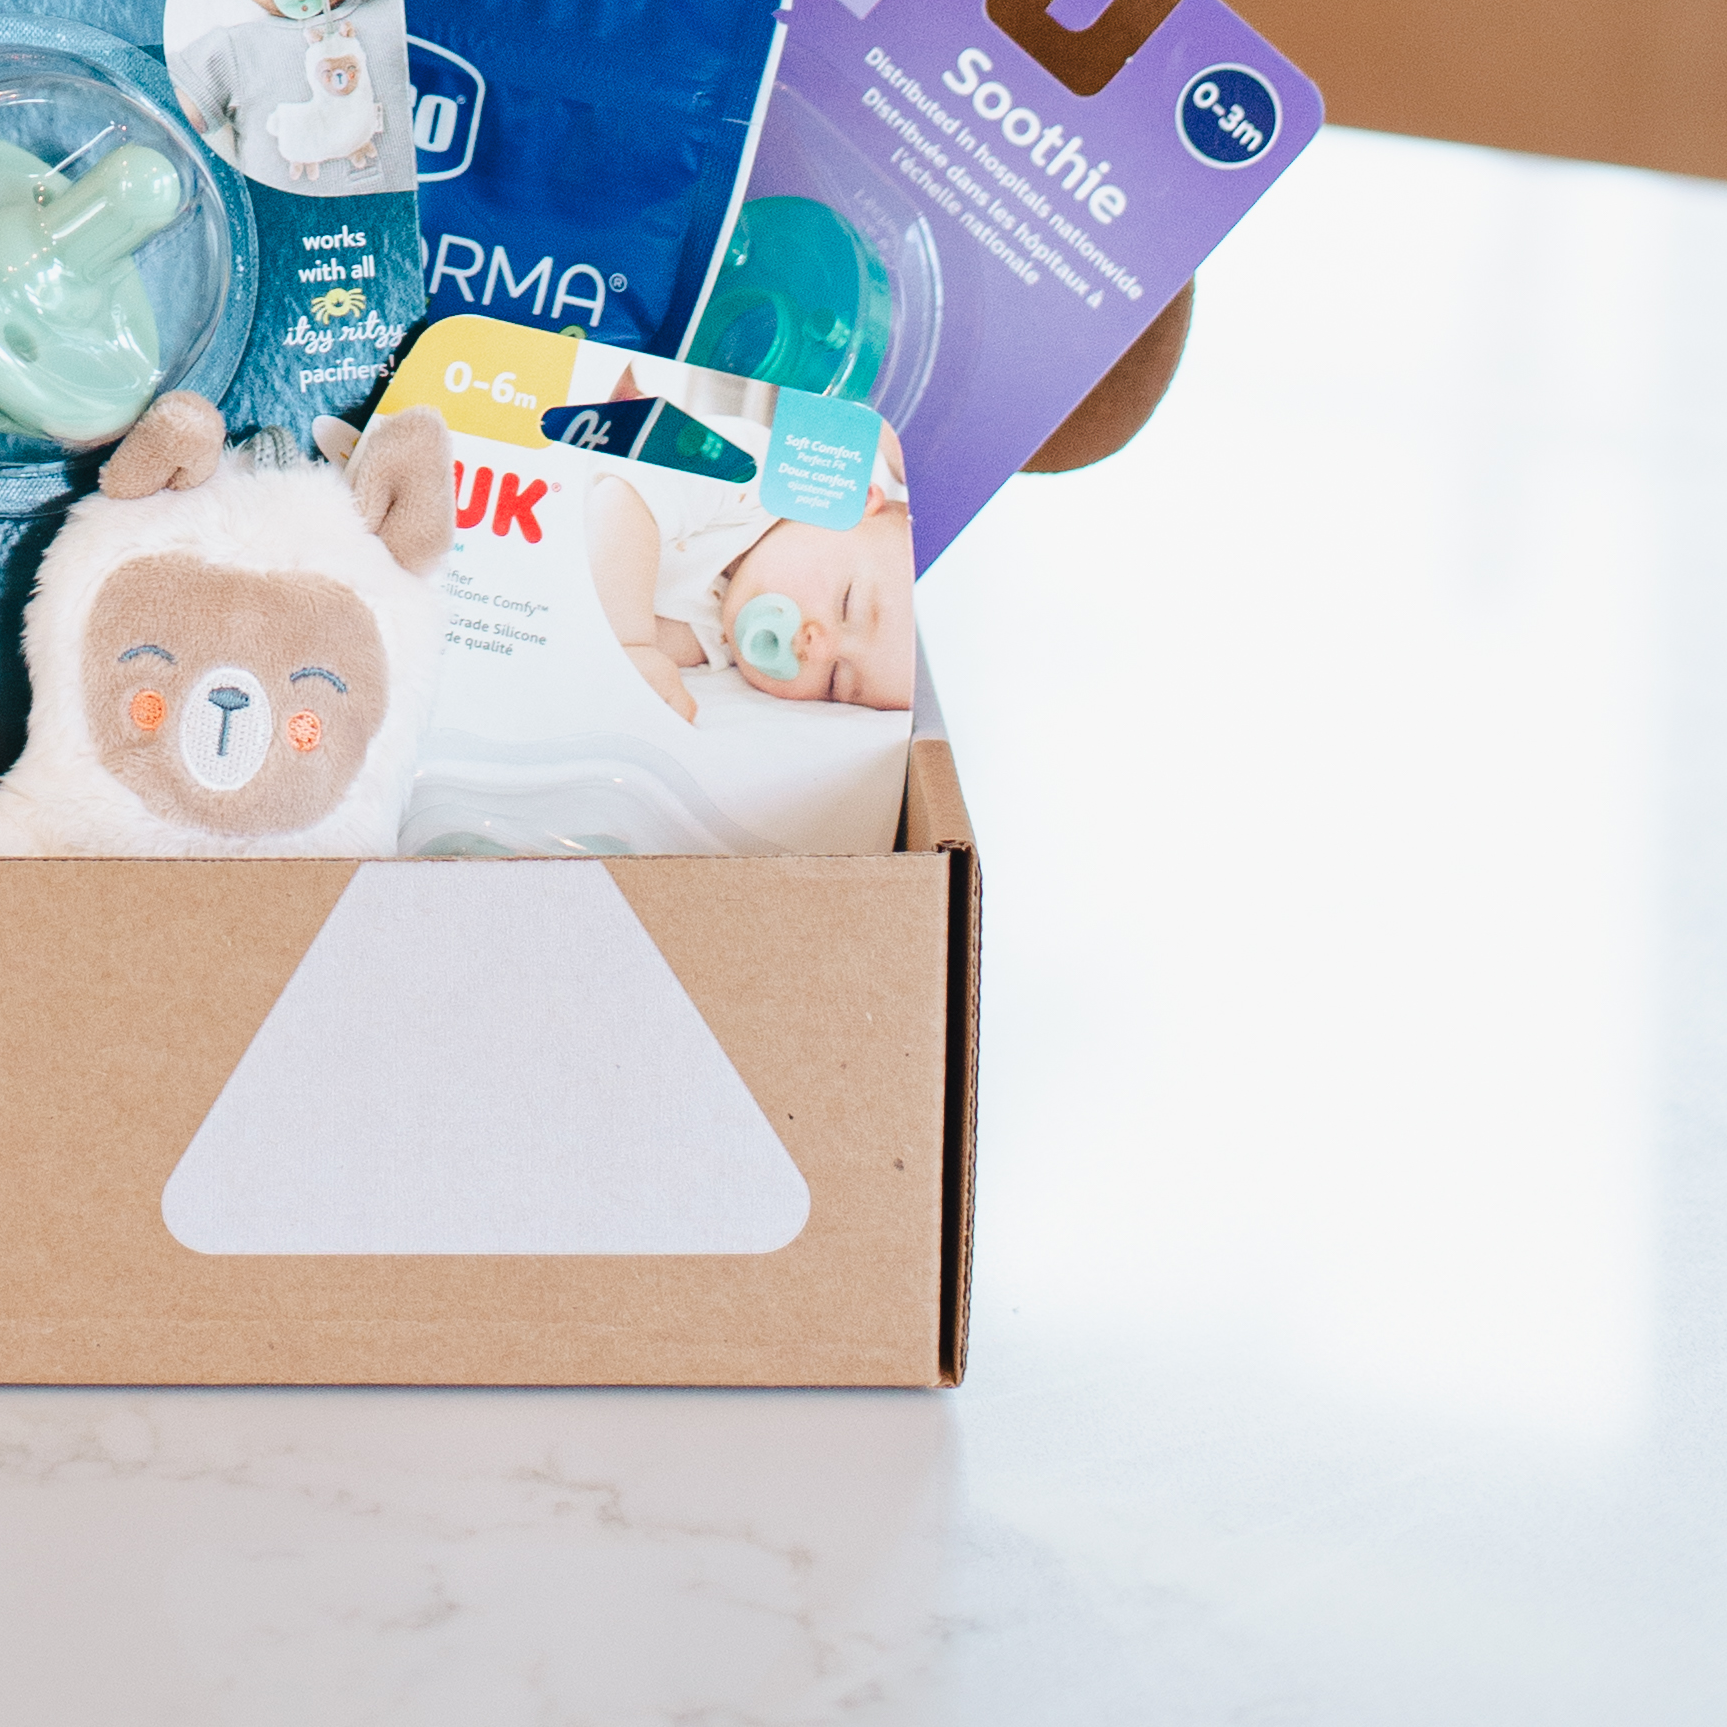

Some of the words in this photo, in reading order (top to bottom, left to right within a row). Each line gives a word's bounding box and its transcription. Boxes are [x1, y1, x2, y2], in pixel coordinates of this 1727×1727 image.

[1191, 81, 1264, 153] 0-3m
[942, 46, 1127, 225] Soothie
[864, 47, 958, 135] Distributed
[955, 127, 976, 154] in
[973, 142, 1052, 221] hospitals
[1049, 211, 1144, 301] nationwide
[861, 86, 949, 169] Distribuée
[945, 162, 992, 206] dans
[986, 198, 1017, 232] les
[1013, 222, 1089, 297] hôpitaux
[890, 146, 963, 216] l'échelle
[960, 210, 1041, 287] nationale
[302, 225, 367, 251] works
[298, 258, 346, 283] with
[351, 255, 375, 280] all
[282, 315, 335, 355] itzy
[443, 361, 538, 410] 0-6m
[784, 434, 811, 451] Soft
[811, 440, 863, 463] Comfort,
[797, 451, 832, 467] Perfect
[831, 459, 847, 471] Fit
[778, 462, 810, 479] Doux
[811, 472, 857, 491] confort,
[447, 569, 473, 586] ifier
[441, 583, 490, 604] ilicone
[445, 630, 462, 644] de
[464, 636, 514, 656] qualité
[492, 623, 547, 646] Silicone
